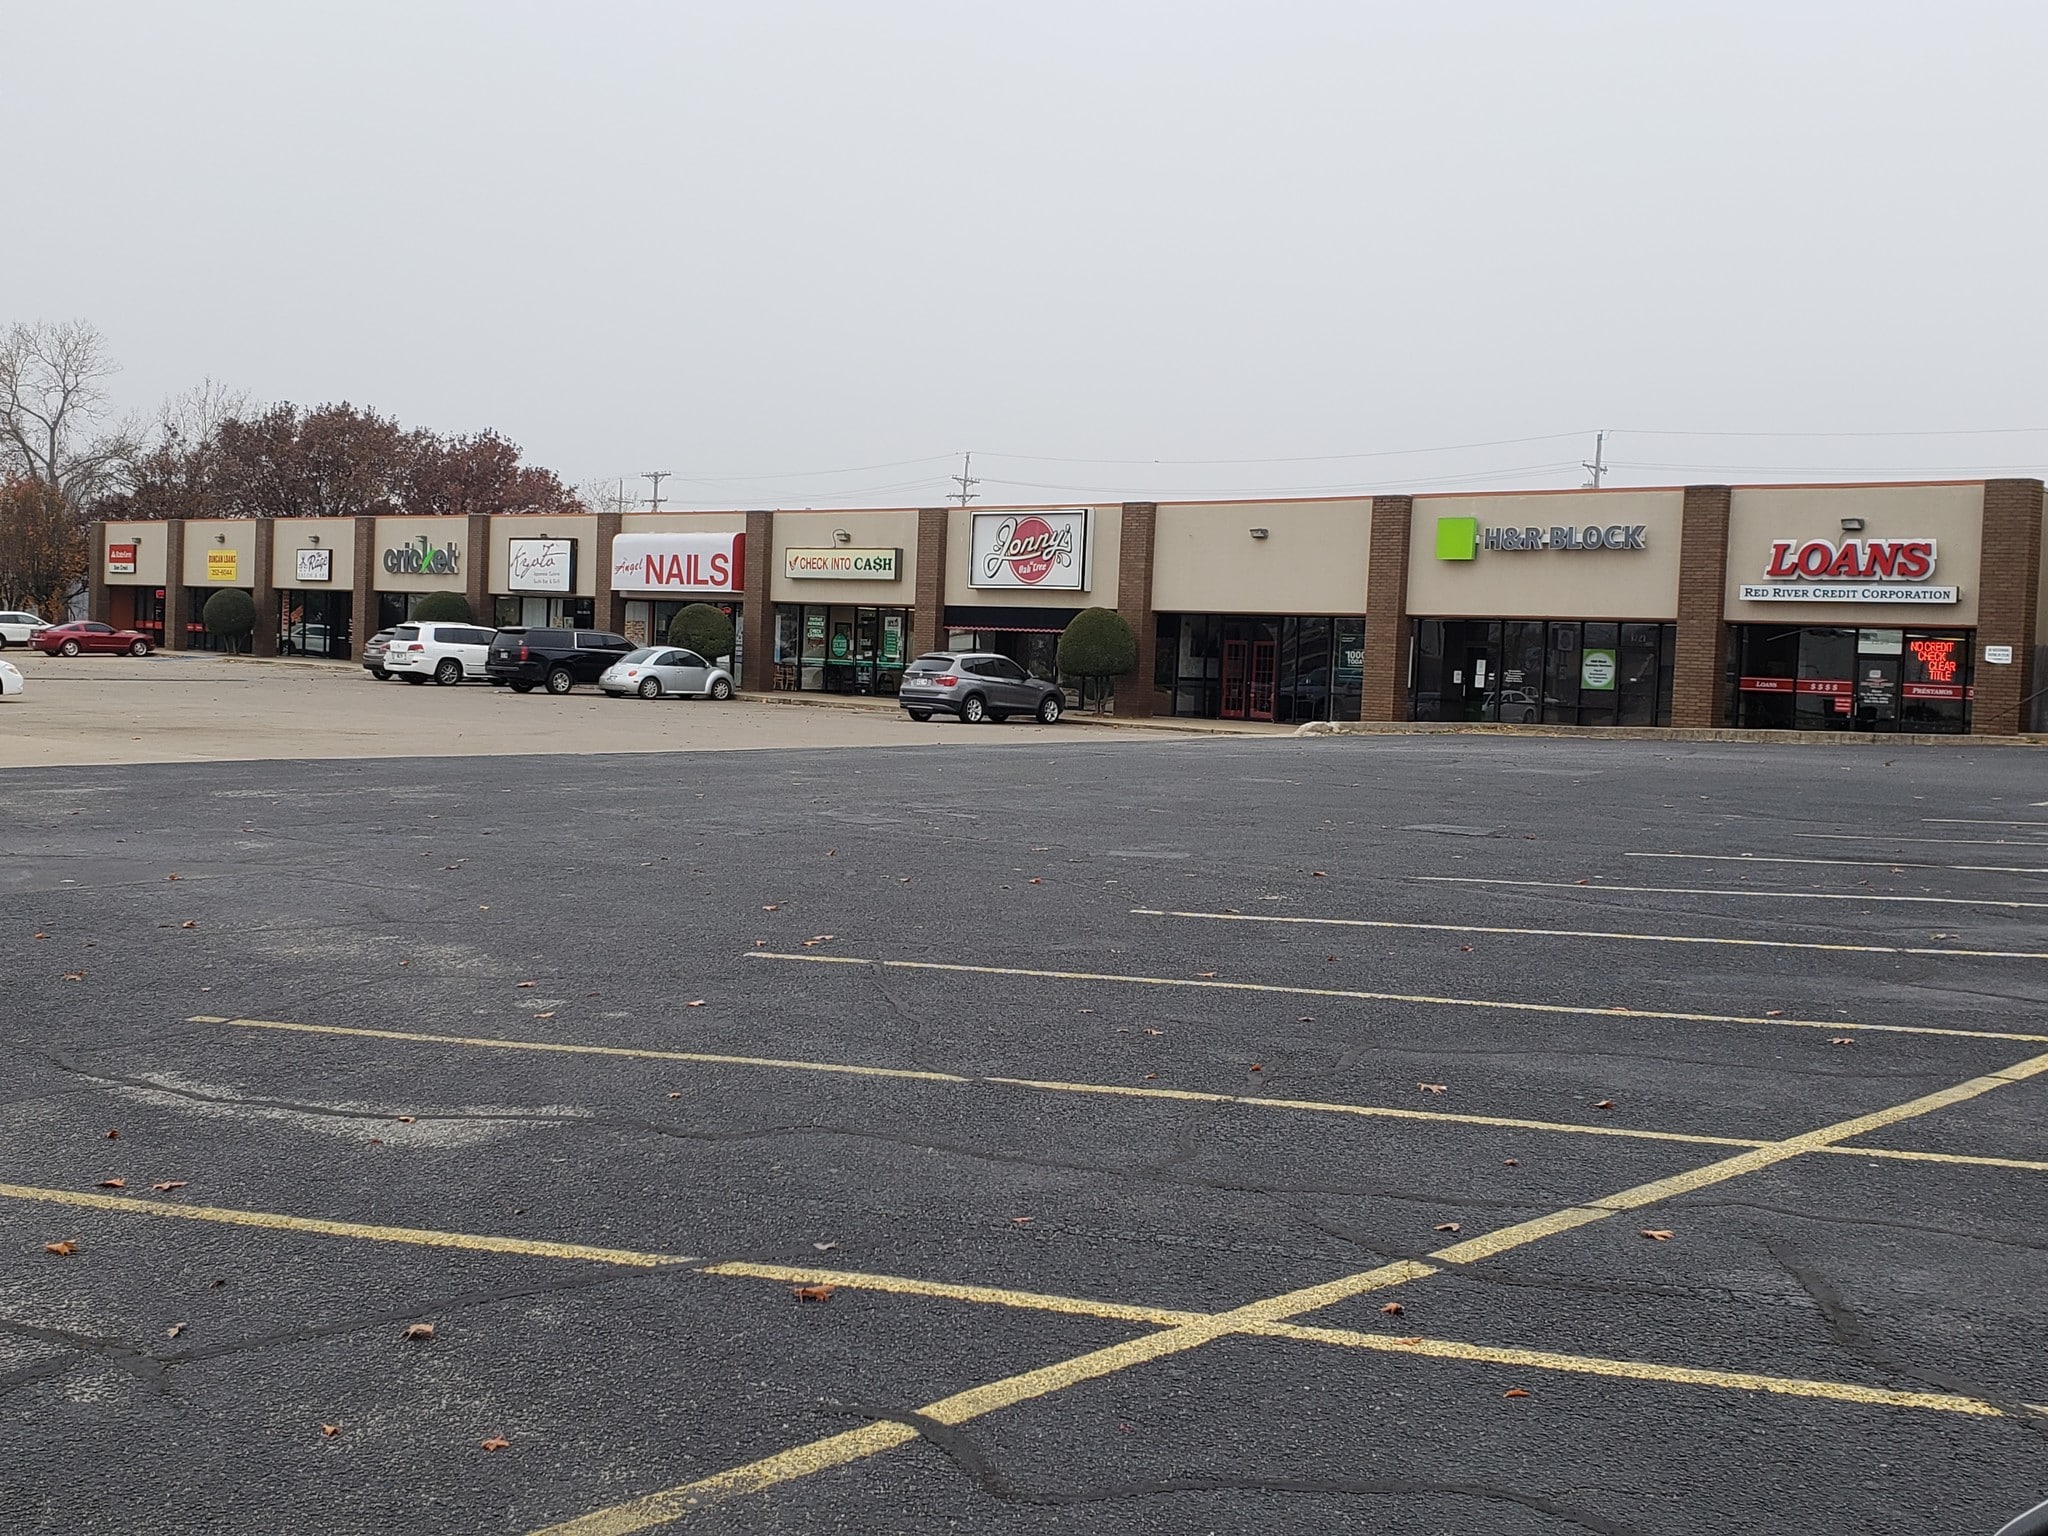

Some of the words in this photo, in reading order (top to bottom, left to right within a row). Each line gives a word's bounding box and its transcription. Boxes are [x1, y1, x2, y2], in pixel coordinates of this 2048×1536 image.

[1484, 526, 1543, 550] H&R
[1549, 525, 1647, 549] BLOCK
[382, 534, 460, 574] cricket
[983, 516, 1072, 578] Jonny's
[208, 555, 223, 563] DUNCAN
[224, 555, 236, 563] LOANS
[510, 543, 567, 579] Kyoto
[800, 557, 829, 570] CHECK
[831, 557, 851, 571] INTO
[854, 556, 892, 572] CA$H
[1766, 542, 1932, 578] LOANS
[615, 557, 643, 575] Angel
[645, 553, 729, 587] NAILS
[1744, 587, 1769, 598] RED
[1773, 587, 1809, 599] RIVER
[1813, 588, 1858, 600] CREDIT
[1861, 588, 1951, 600] CORPORATION
[1910, 641, 1923, 652] NO
[1924, 641, 1954, 653] CREDIT
[1917, 651, 1947, 662] CHECK
[1928, 661, 1956, 672] CLEAR
[1928, 670, 1952, 682] TITLE
